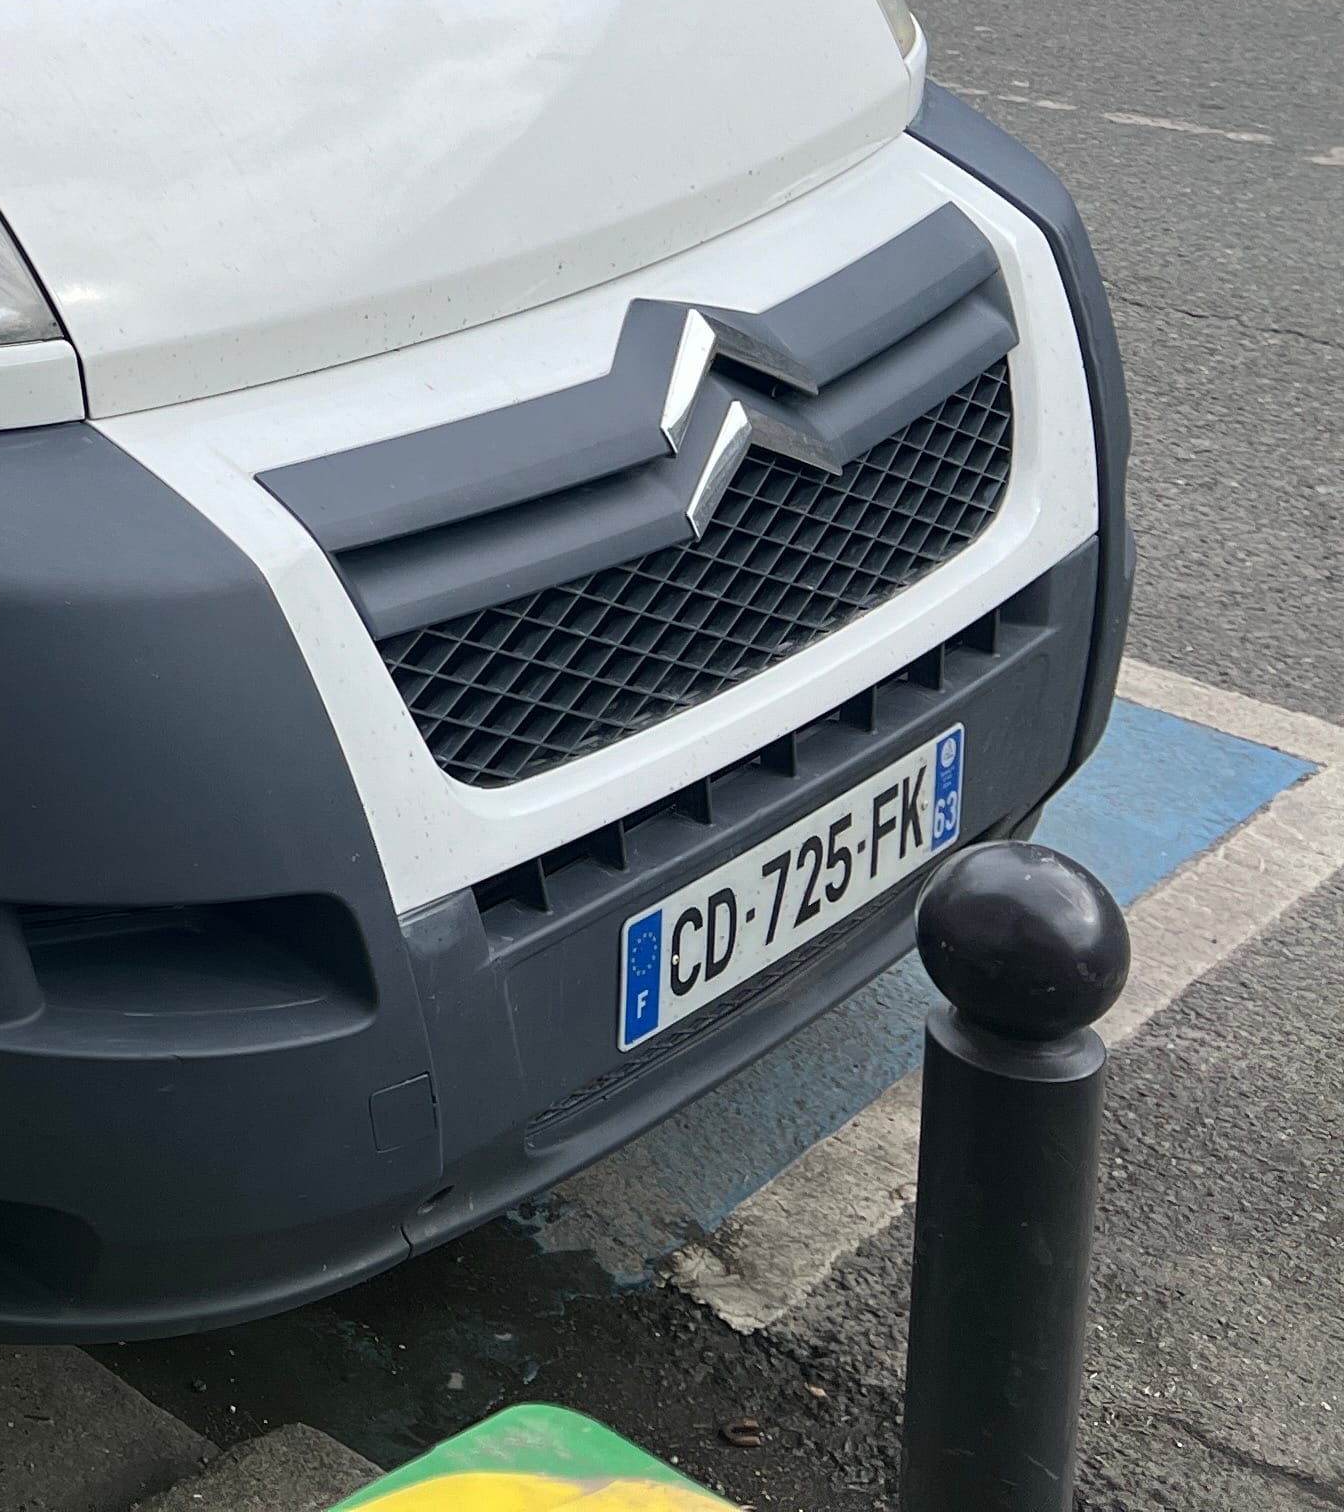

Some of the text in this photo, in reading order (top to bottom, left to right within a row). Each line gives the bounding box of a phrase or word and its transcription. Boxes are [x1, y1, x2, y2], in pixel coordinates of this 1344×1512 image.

[636, 991, 649, 1019] F
[669, 765, 929, 997] CD-725-FK
[934, 790, 958, 839] 63
